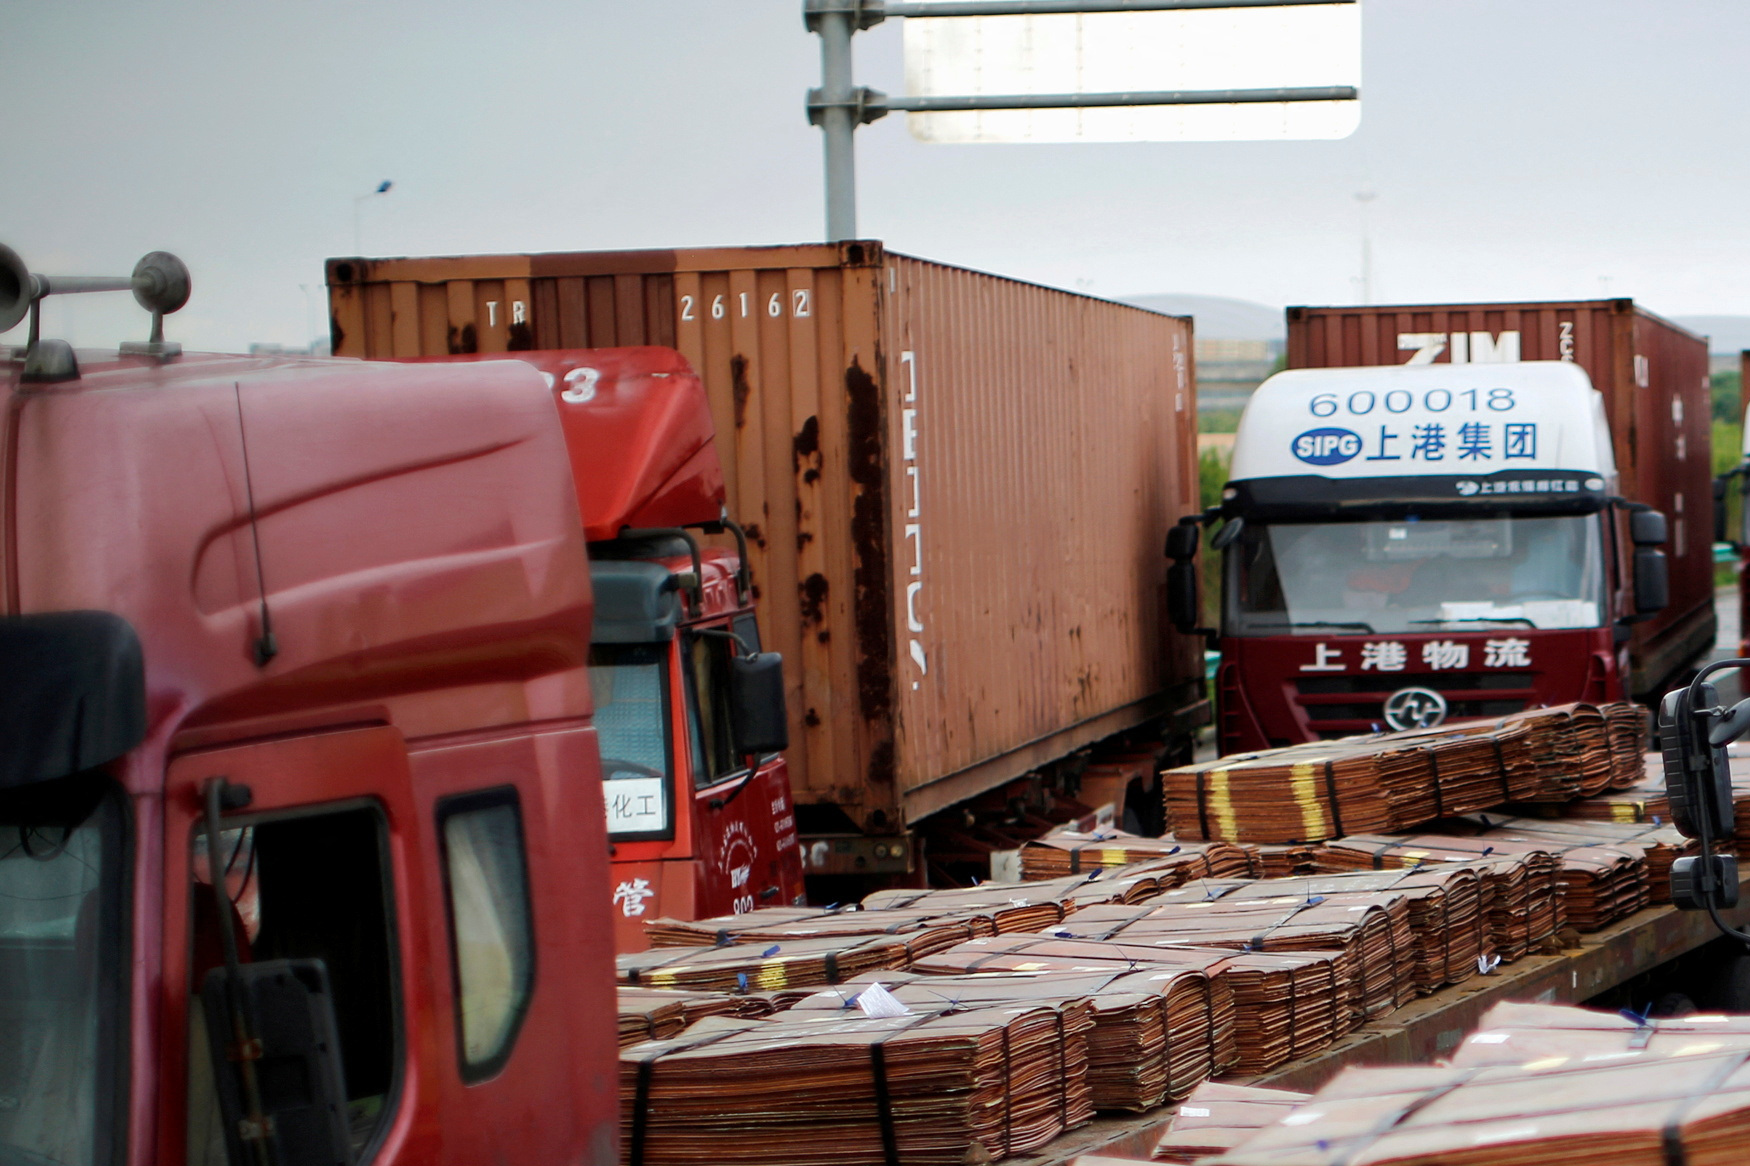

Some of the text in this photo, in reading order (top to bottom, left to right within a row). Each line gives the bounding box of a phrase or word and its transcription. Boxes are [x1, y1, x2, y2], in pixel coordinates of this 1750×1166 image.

[1397, 331, 1521, 366] ZIM
[1310, 389, 1516, 417] 600018
[1296, 435, 1360, 458] SIPG
[1366, 422, 1538, 462] 上港集团
[1299, 639, 1532, 671] 上港物流
